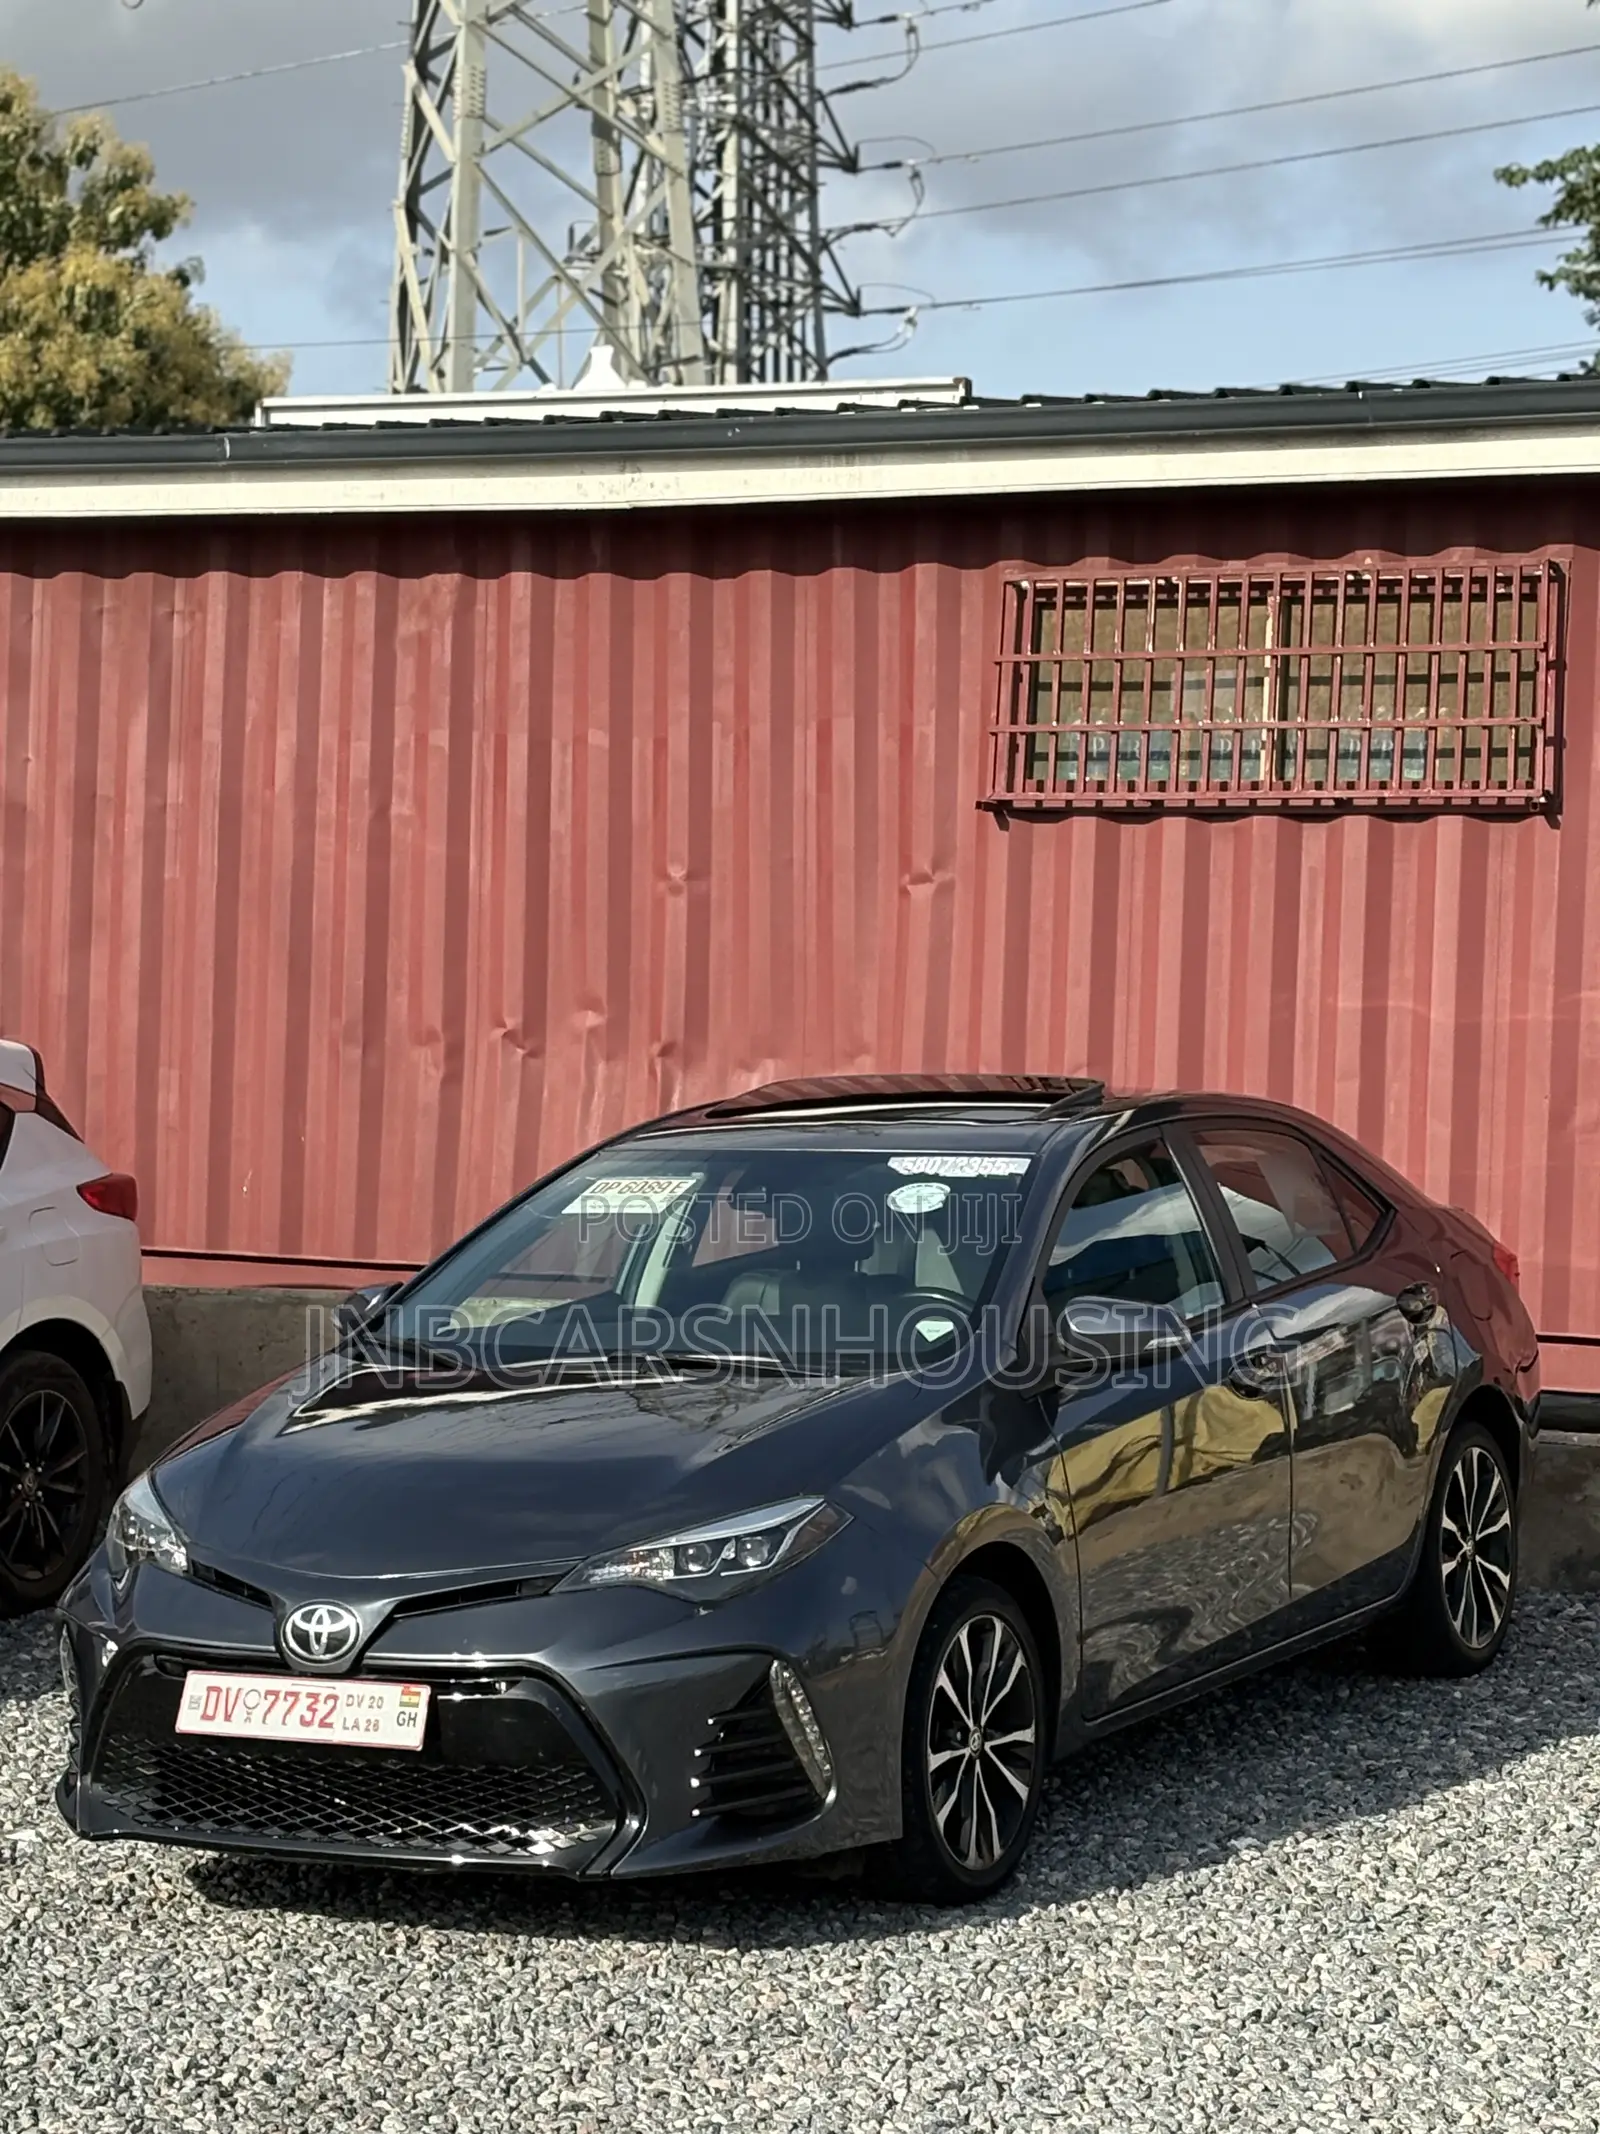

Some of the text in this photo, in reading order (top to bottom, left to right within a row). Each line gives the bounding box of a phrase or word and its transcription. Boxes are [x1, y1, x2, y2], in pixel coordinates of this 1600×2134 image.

[590, 1181, 623, 1194] DP
[668, 1180, 688, 1194] E
[200, 1685, 243, 1723] DV
[262, 1689, 340, 1729] 7732
[345, 1694, 385, 1710] DV 20
[342, 1716, 361, 1732] LA
[396, 1710, 418, 1728] GH
